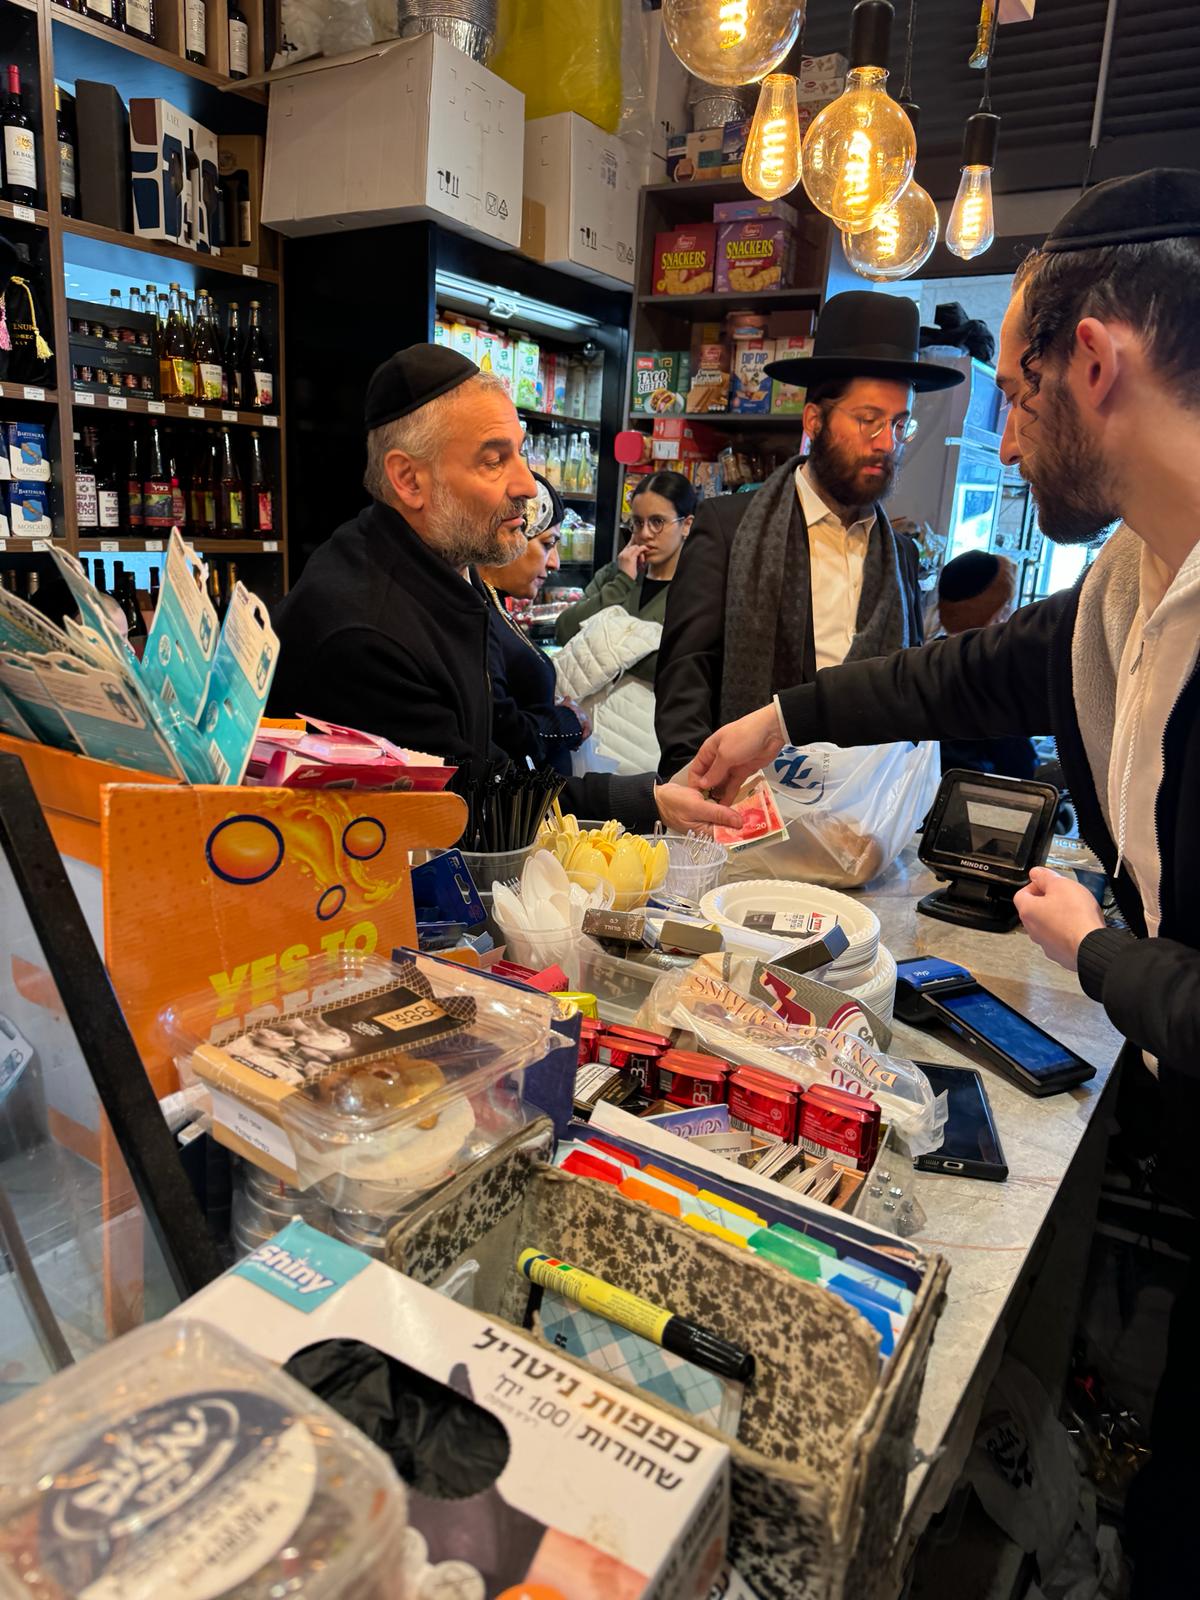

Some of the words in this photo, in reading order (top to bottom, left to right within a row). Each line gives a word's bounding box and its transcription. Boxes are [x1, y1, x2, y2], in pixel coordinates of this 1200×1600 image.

[661, 251, 706, 269] SNACKERS
[726, 240, 773, 259] SNACKERS
[742, 352, 754, 364] DIP
[755, 352, 768, 364] DIP
[639, 370, 667, 384] TACO
[755, 822, 767, 830] 20
[960, 859, 989, 871] MINDEO
[209, 943, 309, 1018] YES
[320, 920, 378, 962] TO
[250, 1244, 336, 1294] Shiny
[473, 1327, 582, 1398] ניטריל
[528, 1394, 571, 1429] 100
[581, 1389, 703, 1464] כפפות
[576, 1424, 683, 1490] שחורות
